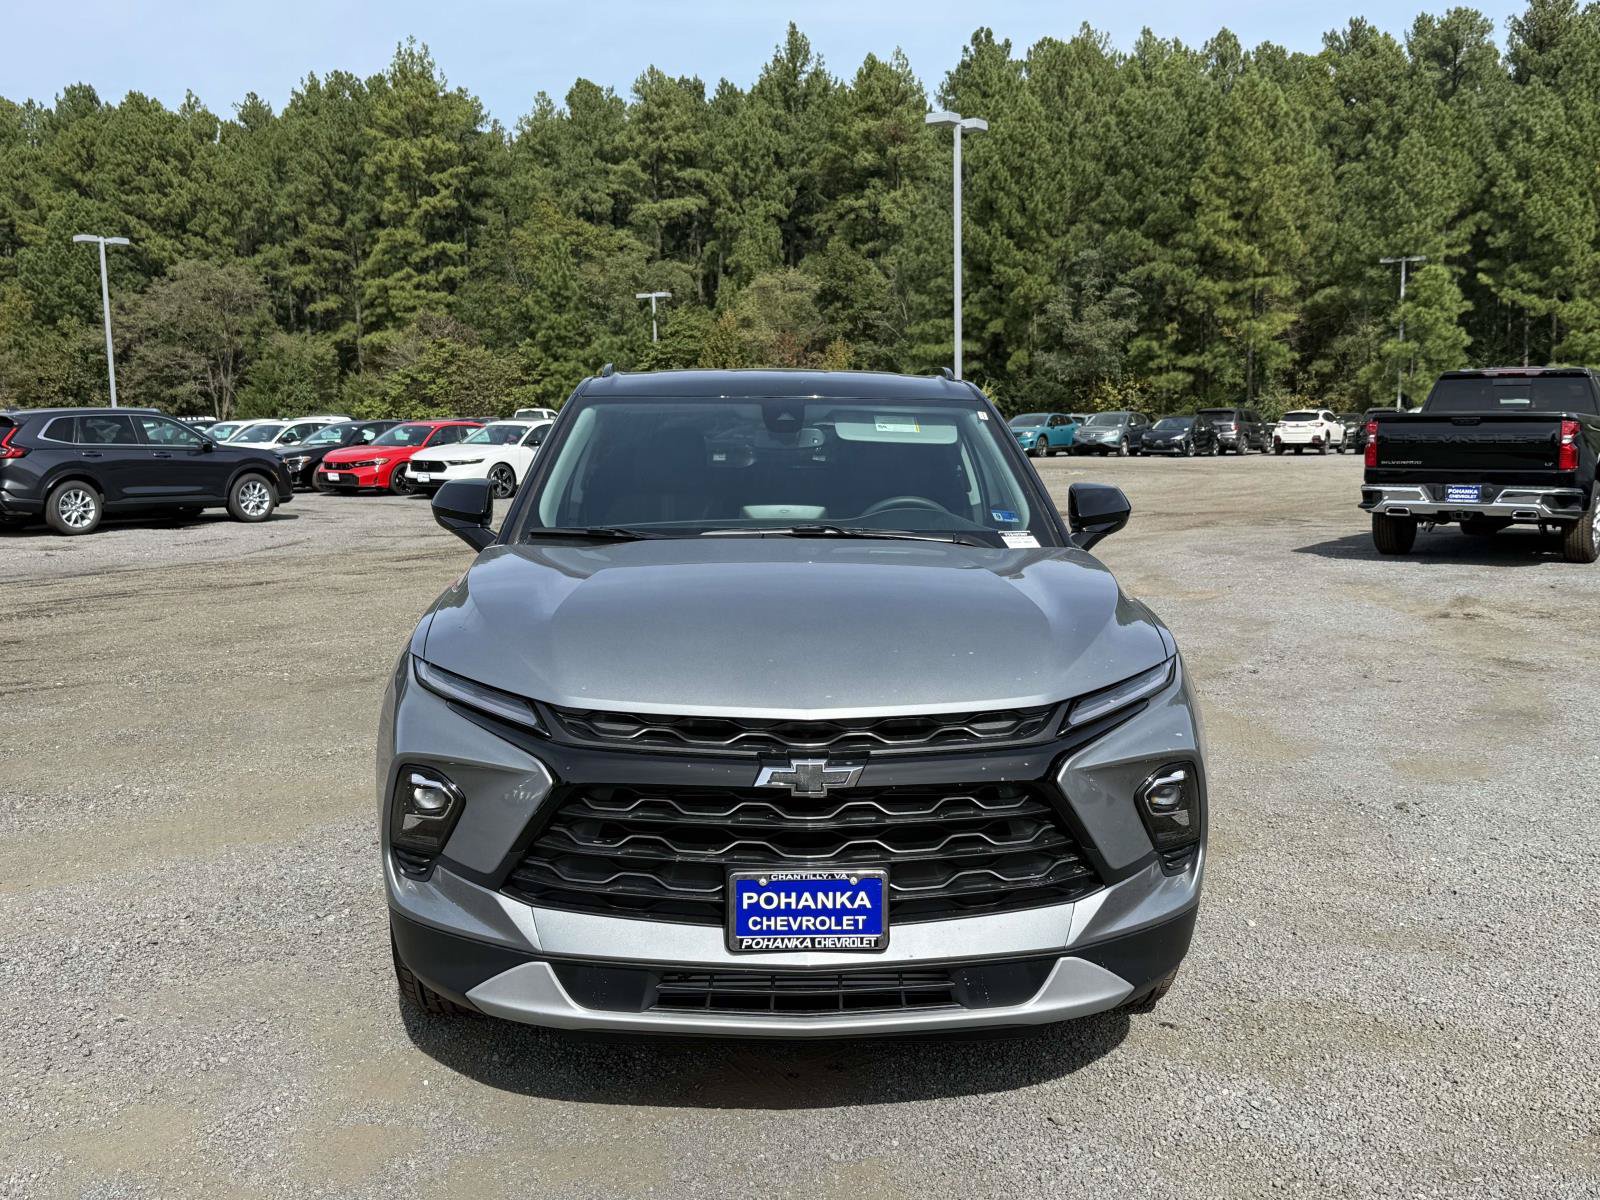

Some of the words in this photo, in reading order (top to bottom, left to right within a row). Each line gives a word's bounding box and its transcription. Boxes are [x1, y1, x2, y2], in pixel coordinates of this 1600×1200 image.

[742, 891, 872, 910] POHANKA
[748, 916, 867, 931] CHEVROLET
[741, 938, 812, 949] POHANKA
[814, 937, 877, 948] CHEVROLET
